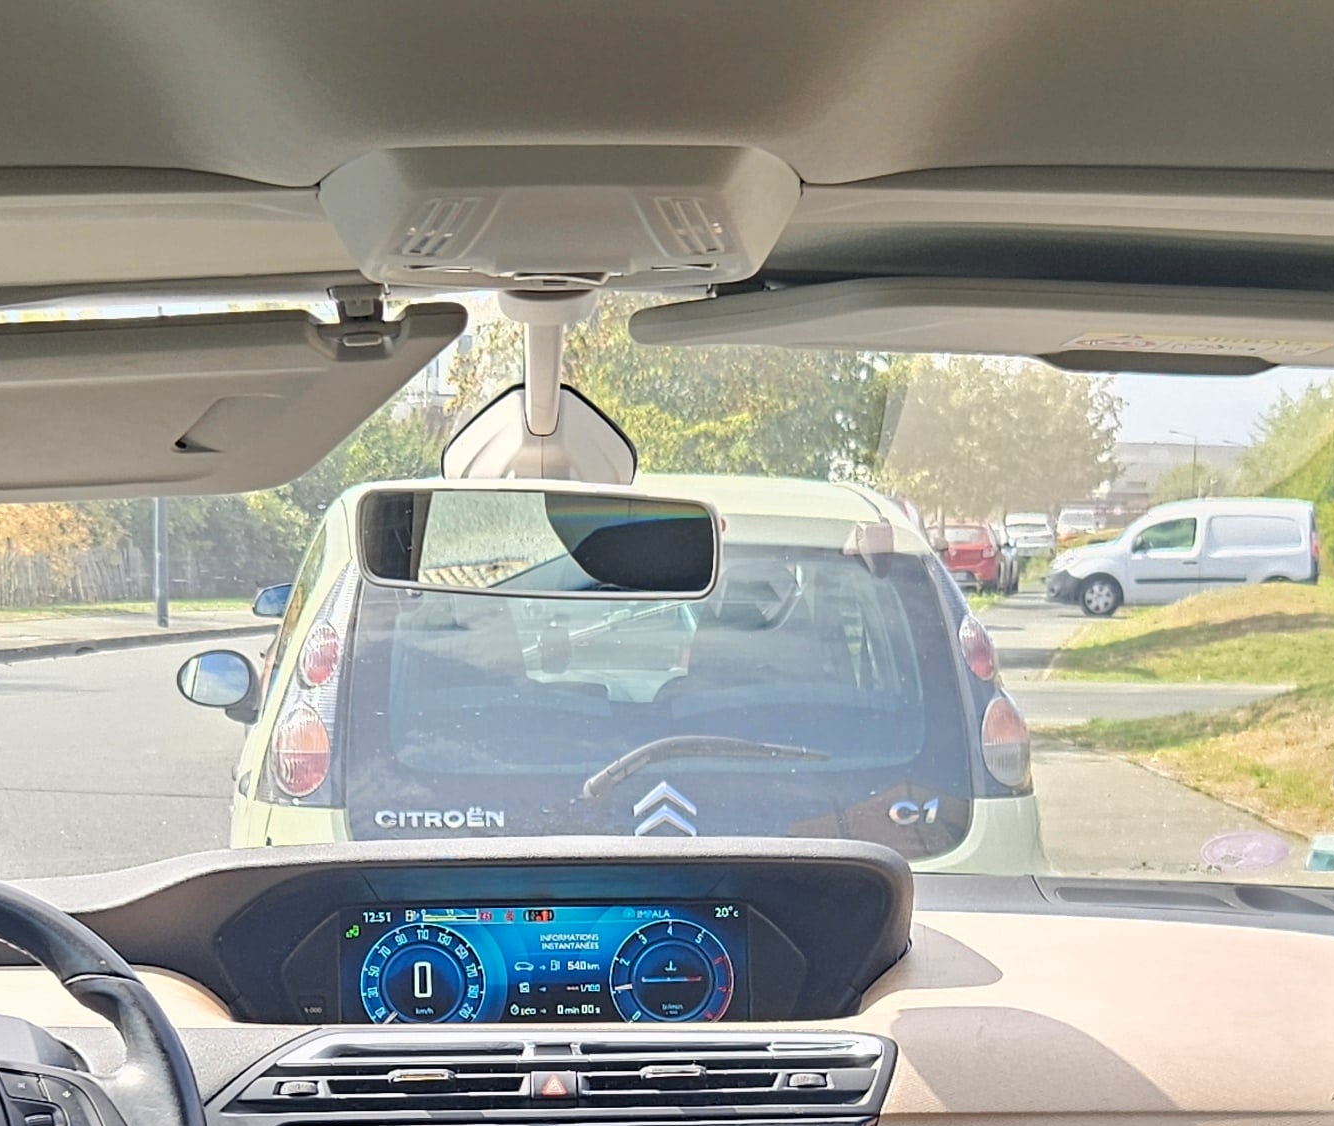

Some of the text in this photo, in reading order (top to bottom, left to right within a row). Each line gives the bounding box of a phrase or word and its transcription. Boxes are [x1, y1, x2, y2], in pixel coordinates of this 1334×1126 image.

[373, 806, 505, 829] CITROËN
[888, 797, 939, 826] C1
[362, 911, 392, 923] 12:51
[636, 909, 671, 919] IMPALA
[416, 929, 429, 940] 110
[666, 924, 673, 936] 4
[394, 933, 408, 946] 90
[539, 933, 599, 942] INFORMATIONS
[637, 933, 648, 945] 3
[694, 933, 704, 944] 5
[378, 945, 392, 959] 70
[567, 960, 586, 970] 540
[619, 957, 631, 967] 2
[367, 965, 379, 977] 50
[413, 961, 433, 998] 0
[564, 1006, 580, 1015] min
